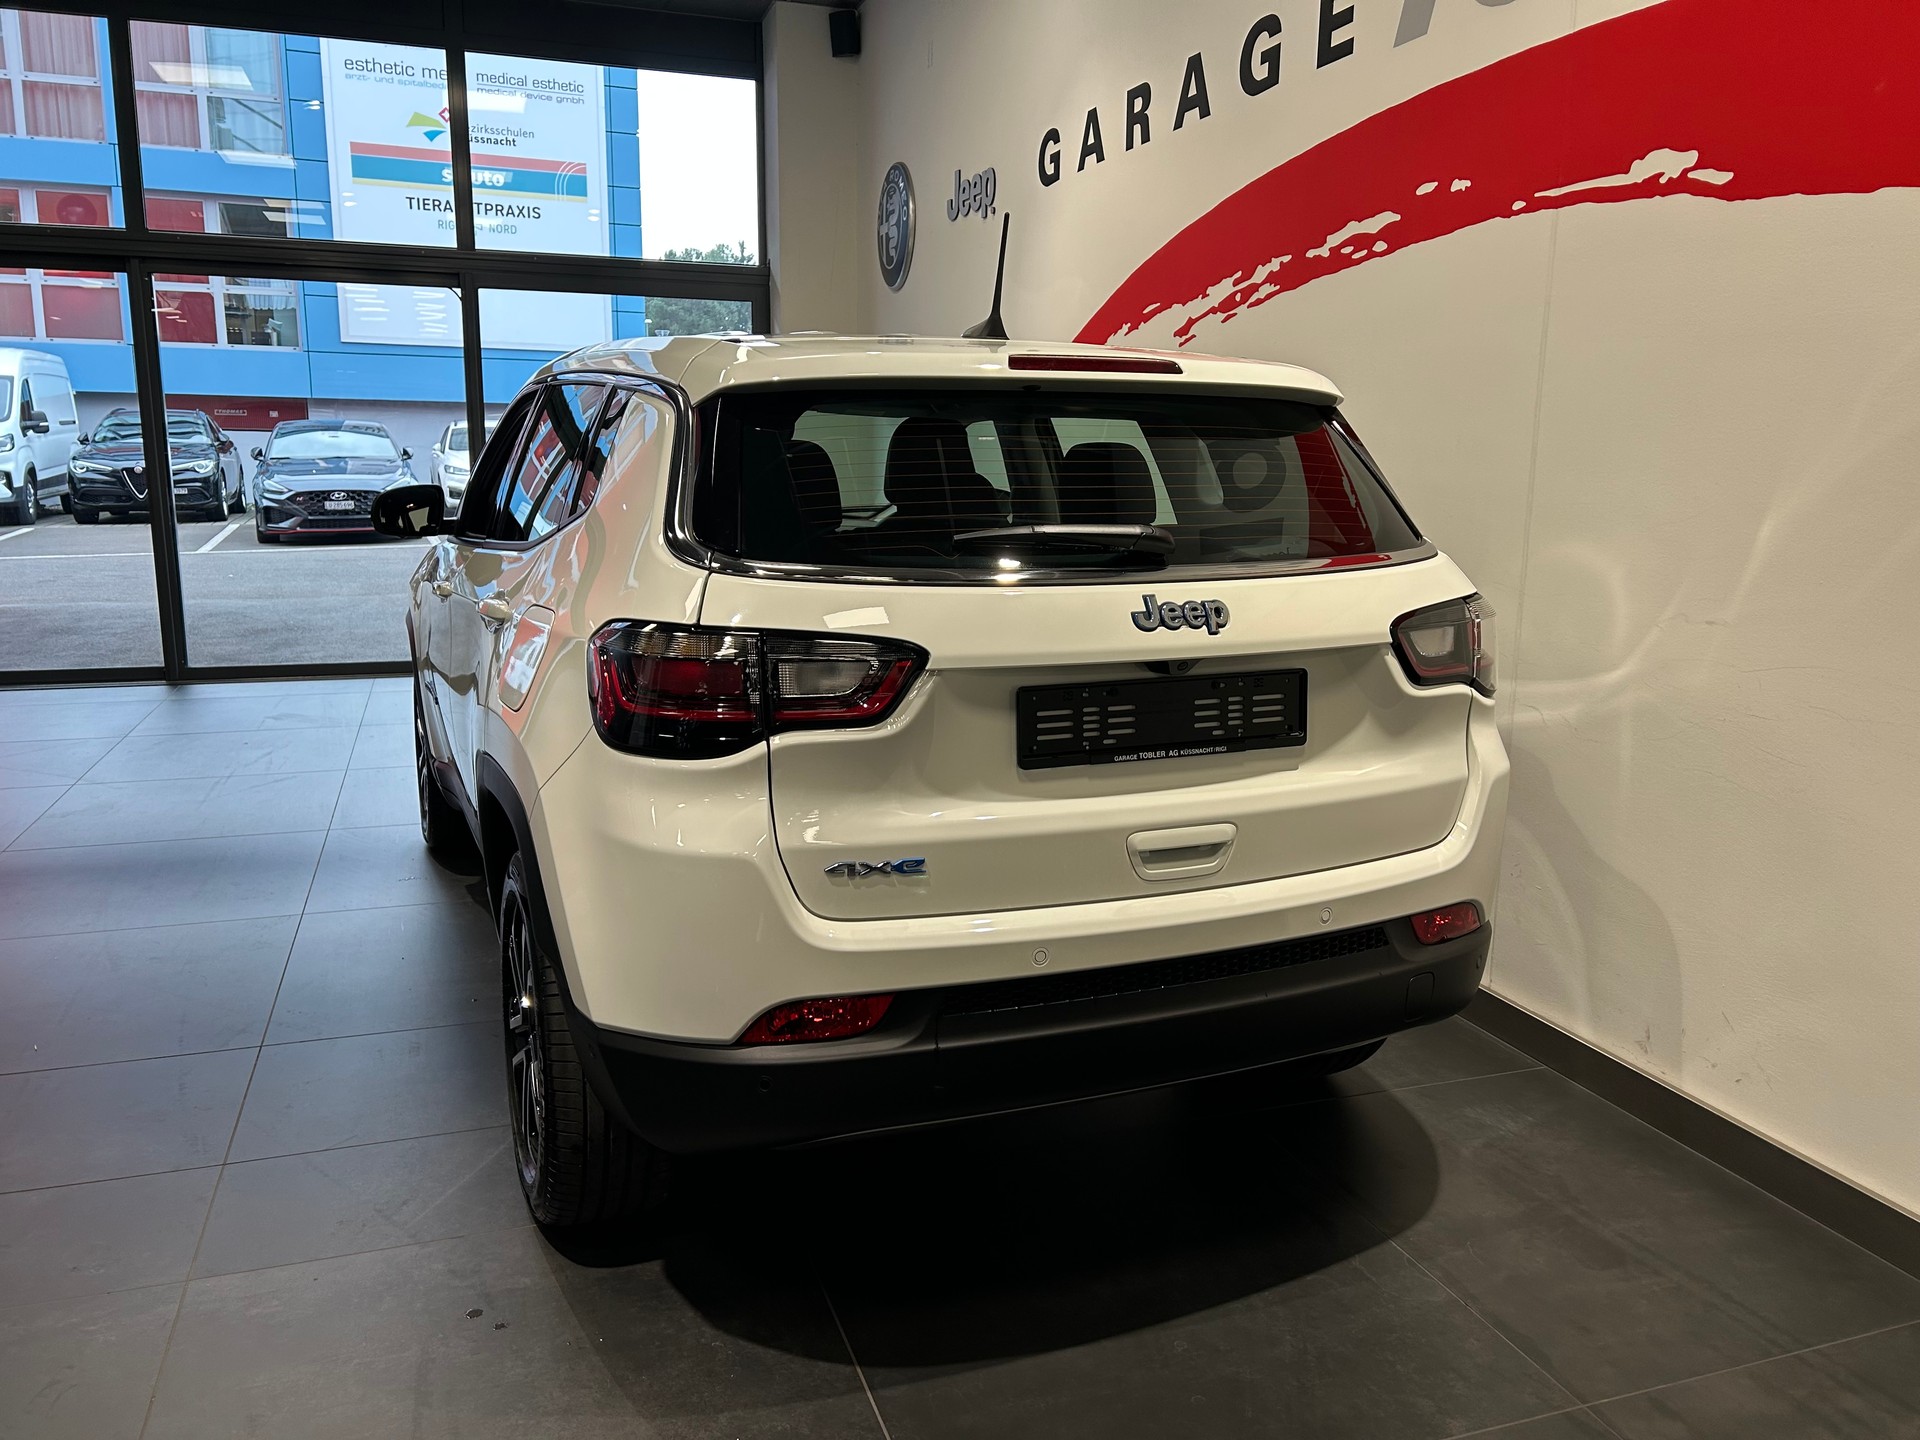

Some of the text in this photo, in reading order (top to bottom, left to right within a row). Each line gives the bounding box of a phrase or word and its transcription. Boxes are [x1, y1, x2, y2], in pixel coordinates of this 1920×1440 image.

[344, 58, 415, 77] esthetic
[374, 76, 394, 84] und
[476, 72, 584, 93] medical esthetic
[477, 87, 585, 105] medical device gmbh
[1038, 0, 1355, 188] GARAGE
[946, 166, 997, 222] Jeep
[405, 196, 541, 219] TIERATPRAXIS
[488, 224, 517, 235] NORD
[1131, 594, 1230, 636] Jeep
[1114, 754, 1138, 762] GARAGE
[1139, 750, 1166, 760] TOBLER
[1168, 749, 1179, 757] AG
